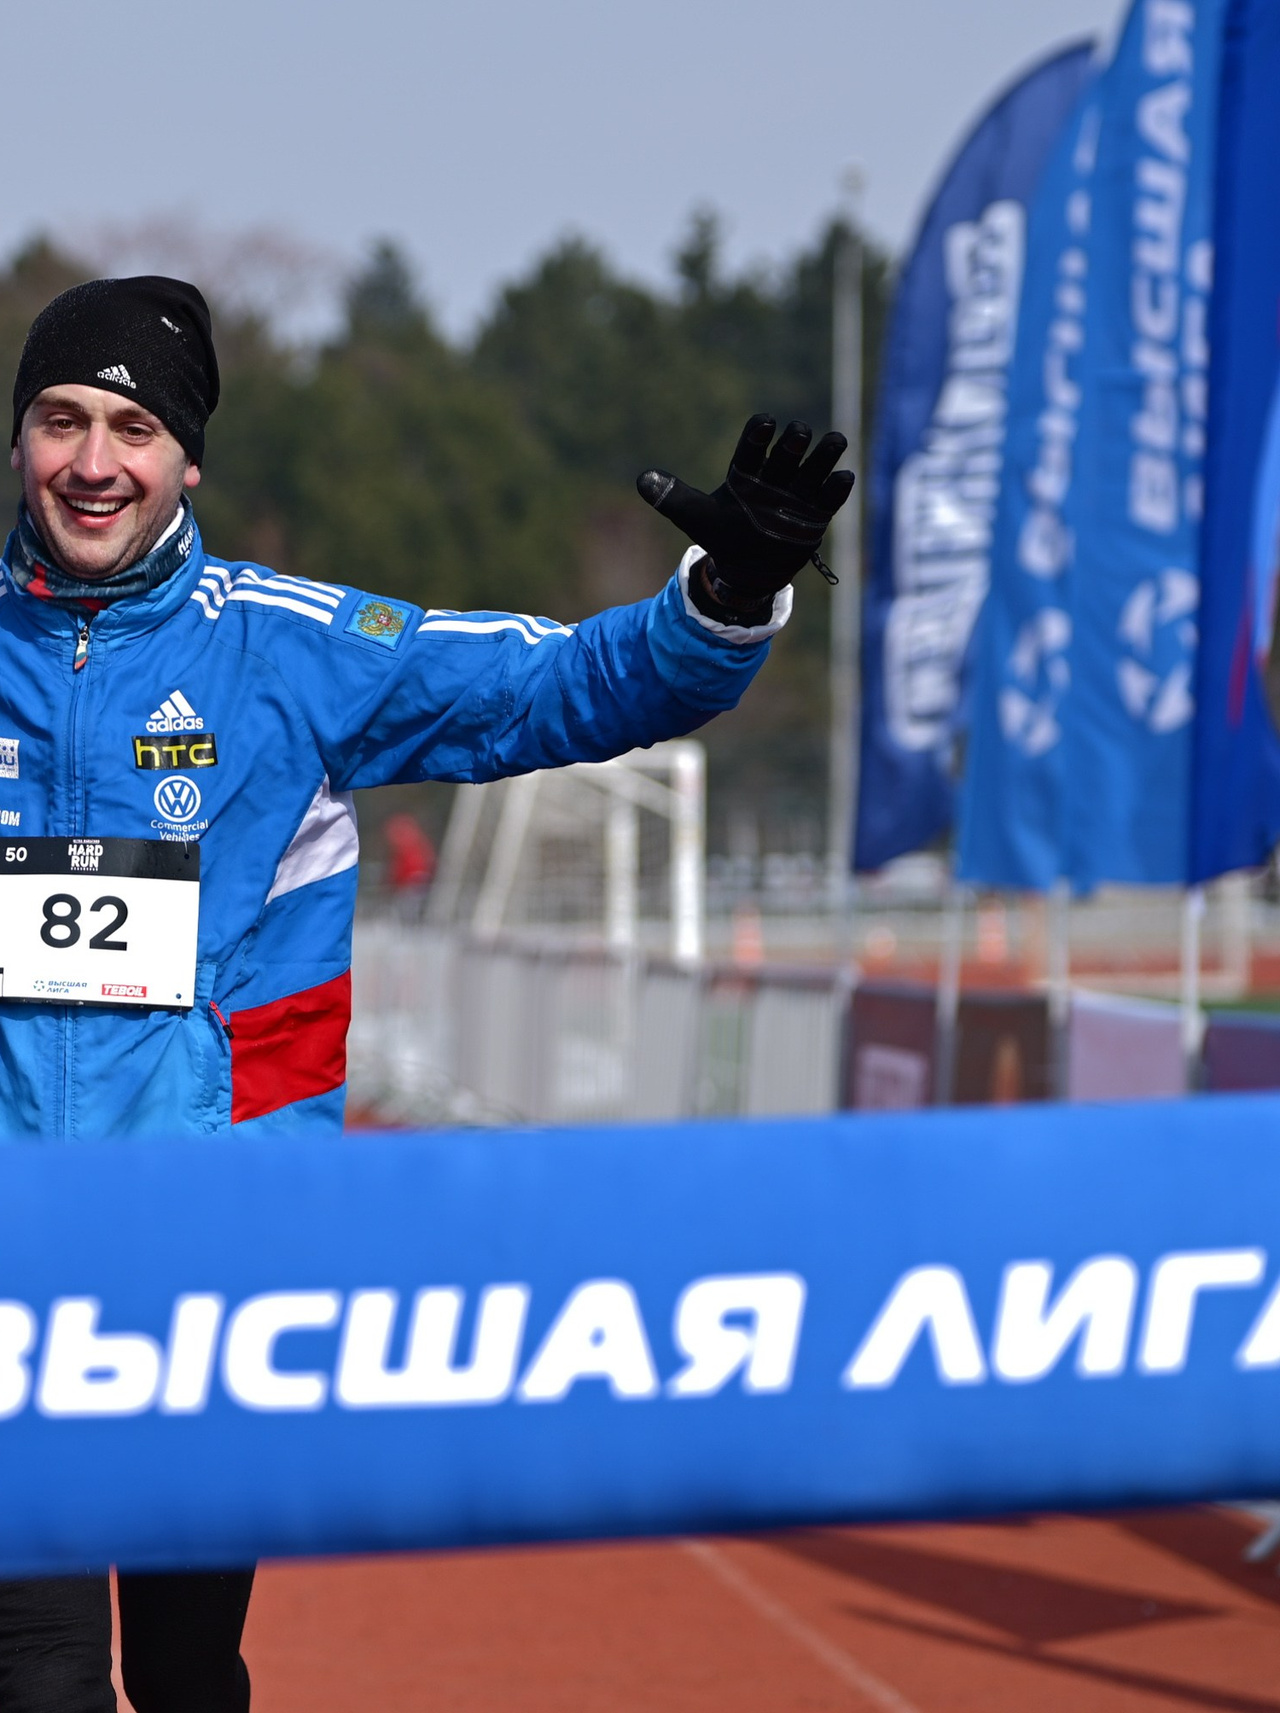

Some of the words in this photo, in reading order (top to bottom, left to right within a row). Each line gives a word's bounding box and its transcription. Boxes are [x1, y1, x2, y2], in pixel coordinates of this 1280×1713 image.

[97, 370, 137, 389] adidas
[146, 716, 204, 733] adidas
[150, 818, 209, 833] Commercial
[5, 846, 28, 862] 50
[67, 844, 104, 857] HARD
[71, 855, 99, 868] RUN
[40, 893, 129, 952] 82
[47, 980, 88, 988] ВЫСШАЯ
[103, 984, 145, 997] TEBOIL
